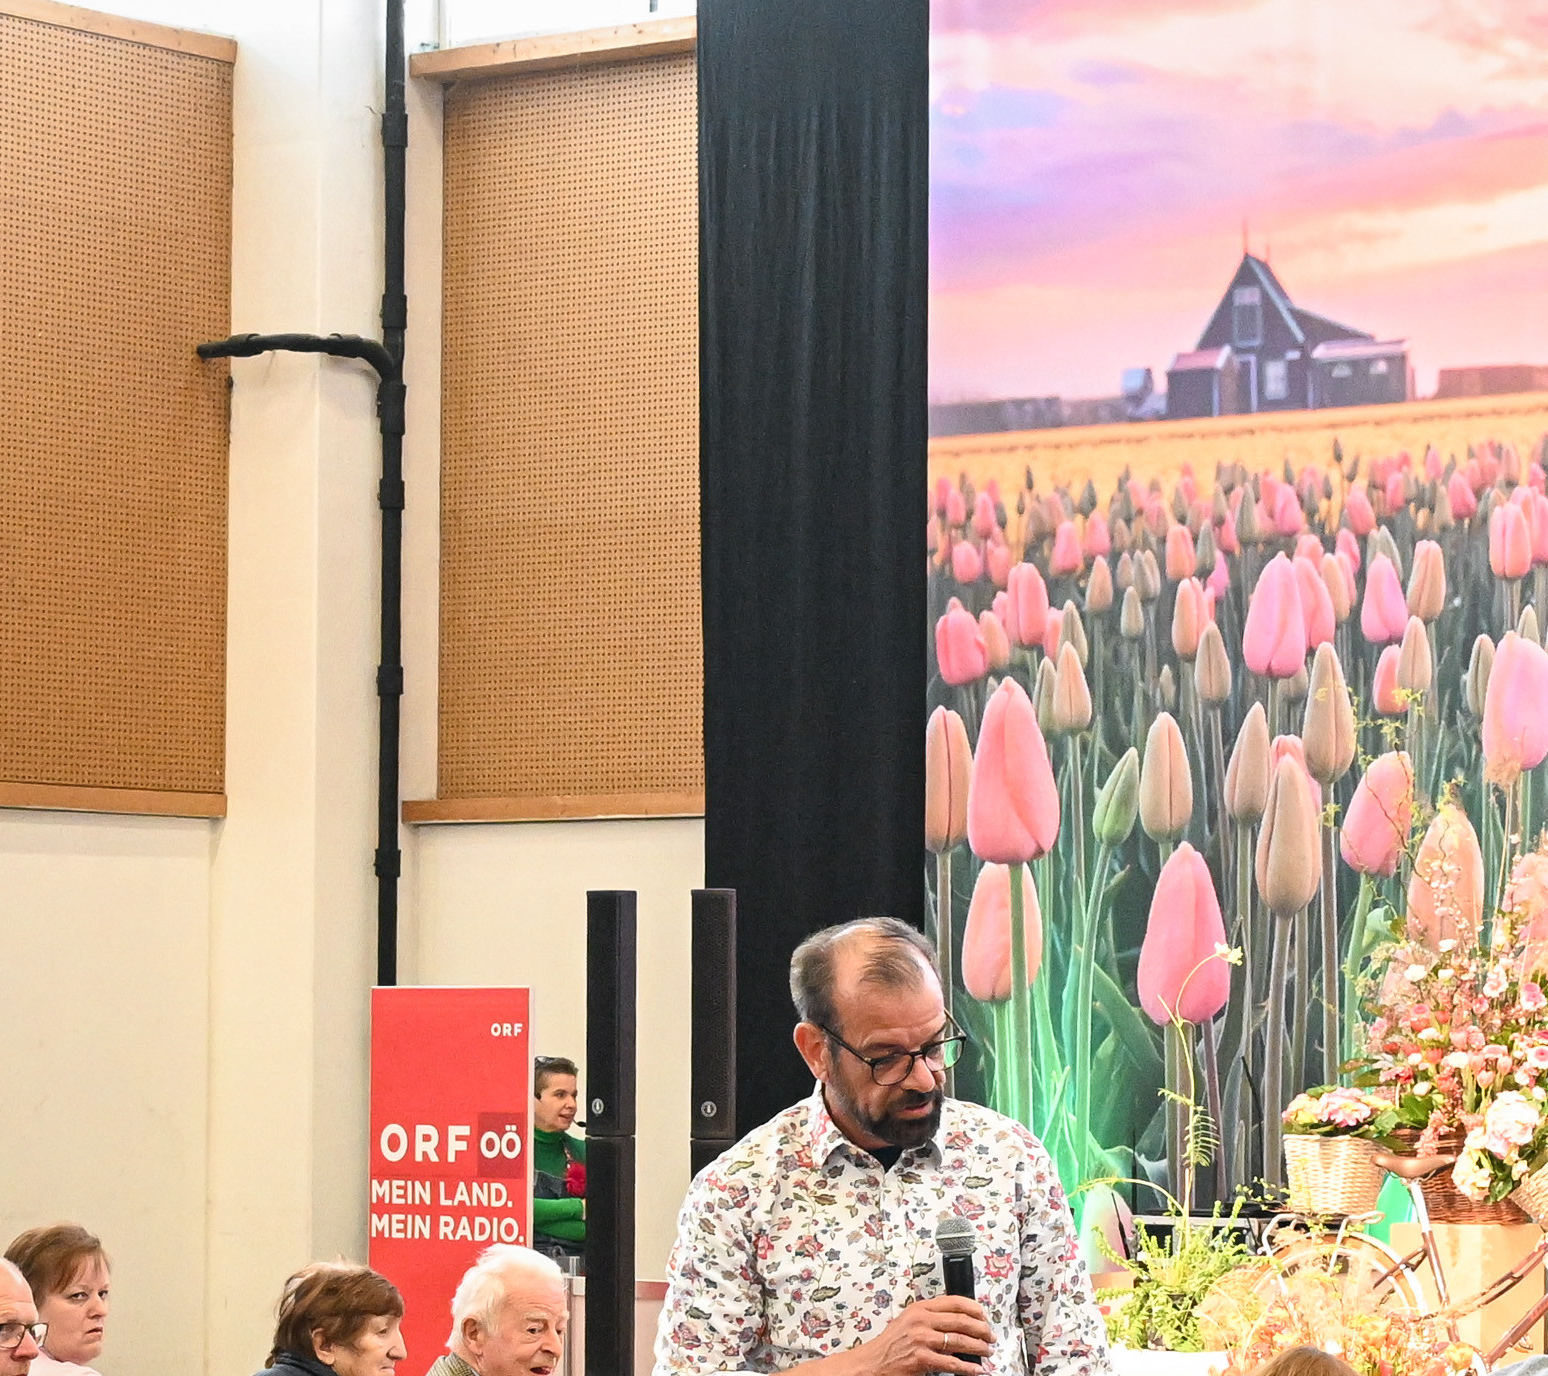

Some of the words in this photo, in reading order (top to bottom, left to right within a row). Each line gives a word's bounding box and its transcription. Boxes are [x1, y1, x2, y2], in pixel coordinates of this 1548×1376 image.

[490, 1023, 524, 1038] ORF
[380, 1123, 471, 1163] ORF
[372, 1179, 431, 1206] MEIN
[439, 1182, 513, 1208] LAND.
[372, 1214, 431, 1240] MEIN
[439, 1216, 525, 1243] RADIO.
